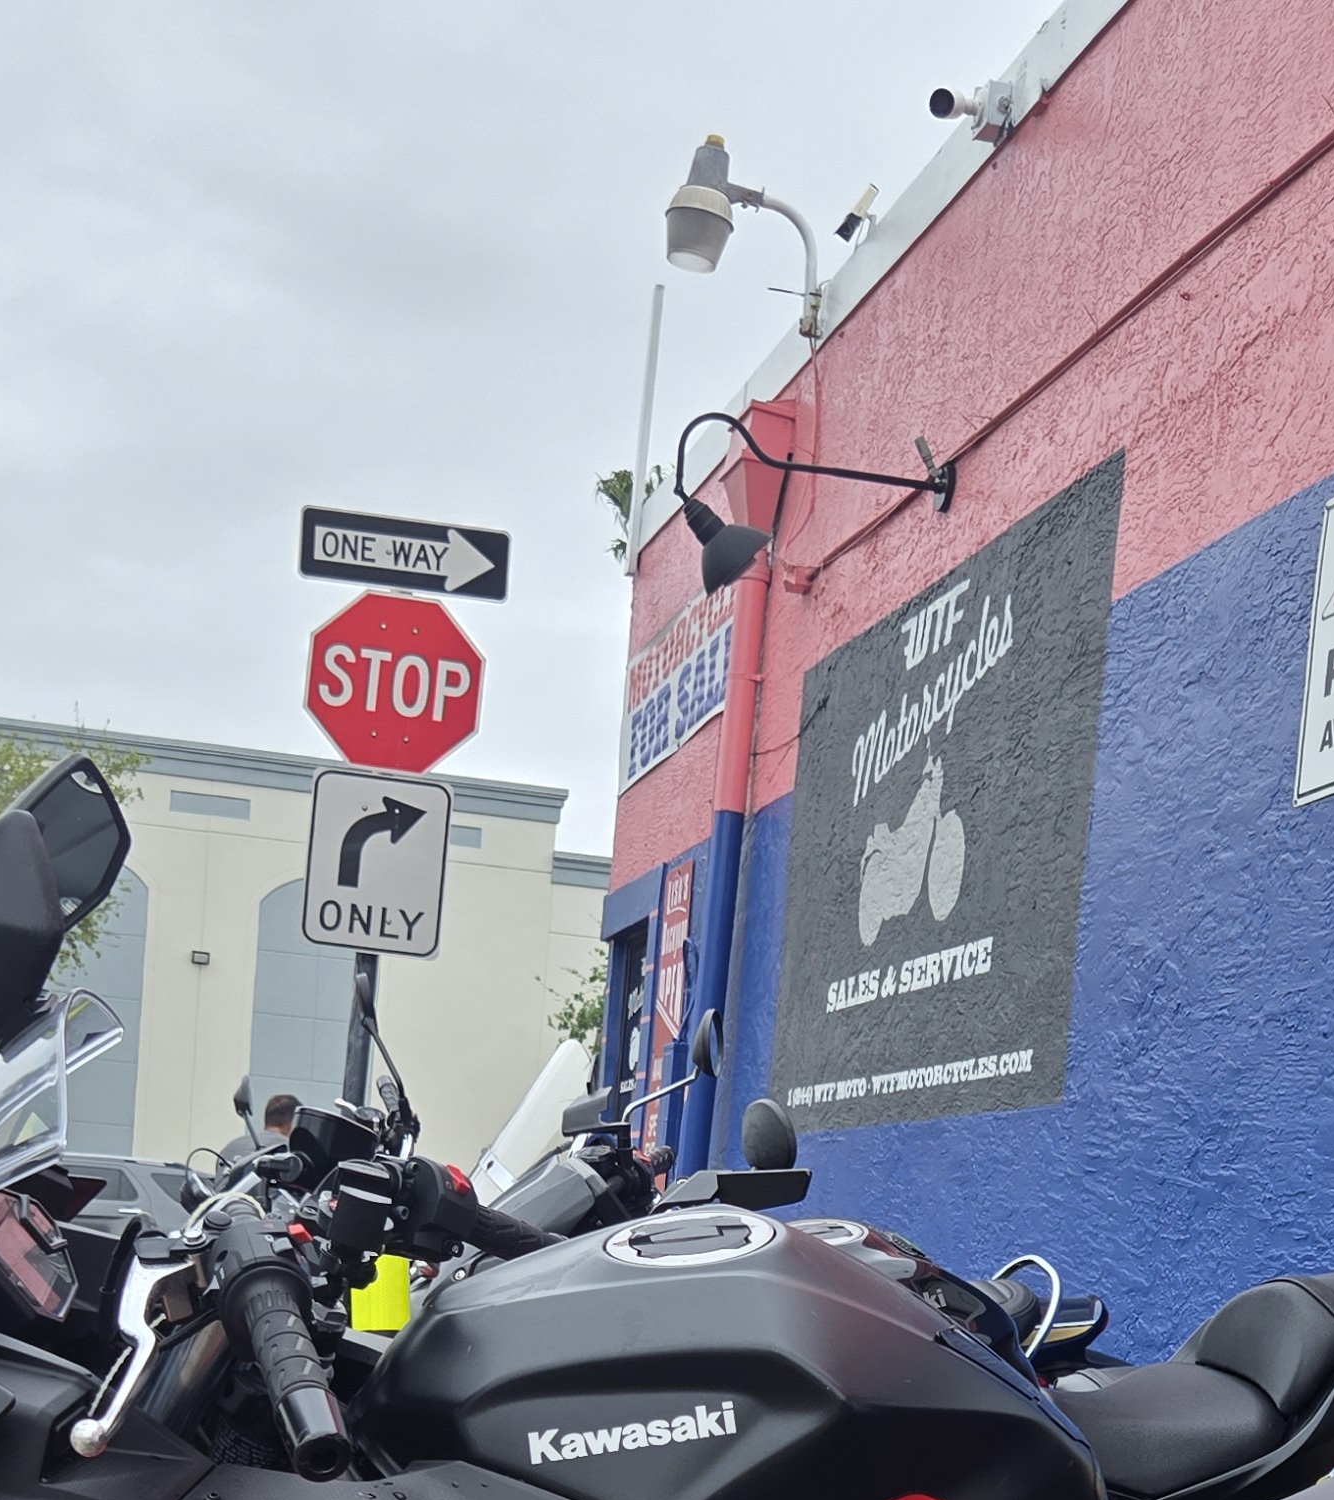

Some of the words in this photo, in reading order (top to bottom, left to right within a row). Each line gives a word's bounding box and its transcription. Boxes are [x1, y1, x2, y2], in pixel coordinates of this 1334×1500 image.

[321, 531, 376, 563] ONE
[391, 539, 450, 572] WAY
[318, 643, 472, 723] STOP
[852, 594, 1014, 807] Motorcycles
[627, 682, 671, 781] FOR
[319, 900, 425, 941] ONLY
[825, 967, 881, 1013] SALES
[881, 965, 897, 998] &
[898, 936, 994, 994] SERVICE
[814, 1082, 836, 1103] WTF
[836, 1077, 867, 1100] MOTO
[871, 1049, 1034, 1095] WTFMOTORCYCLES.COM
[527, 1401, 737, 1465] Kawasaki
